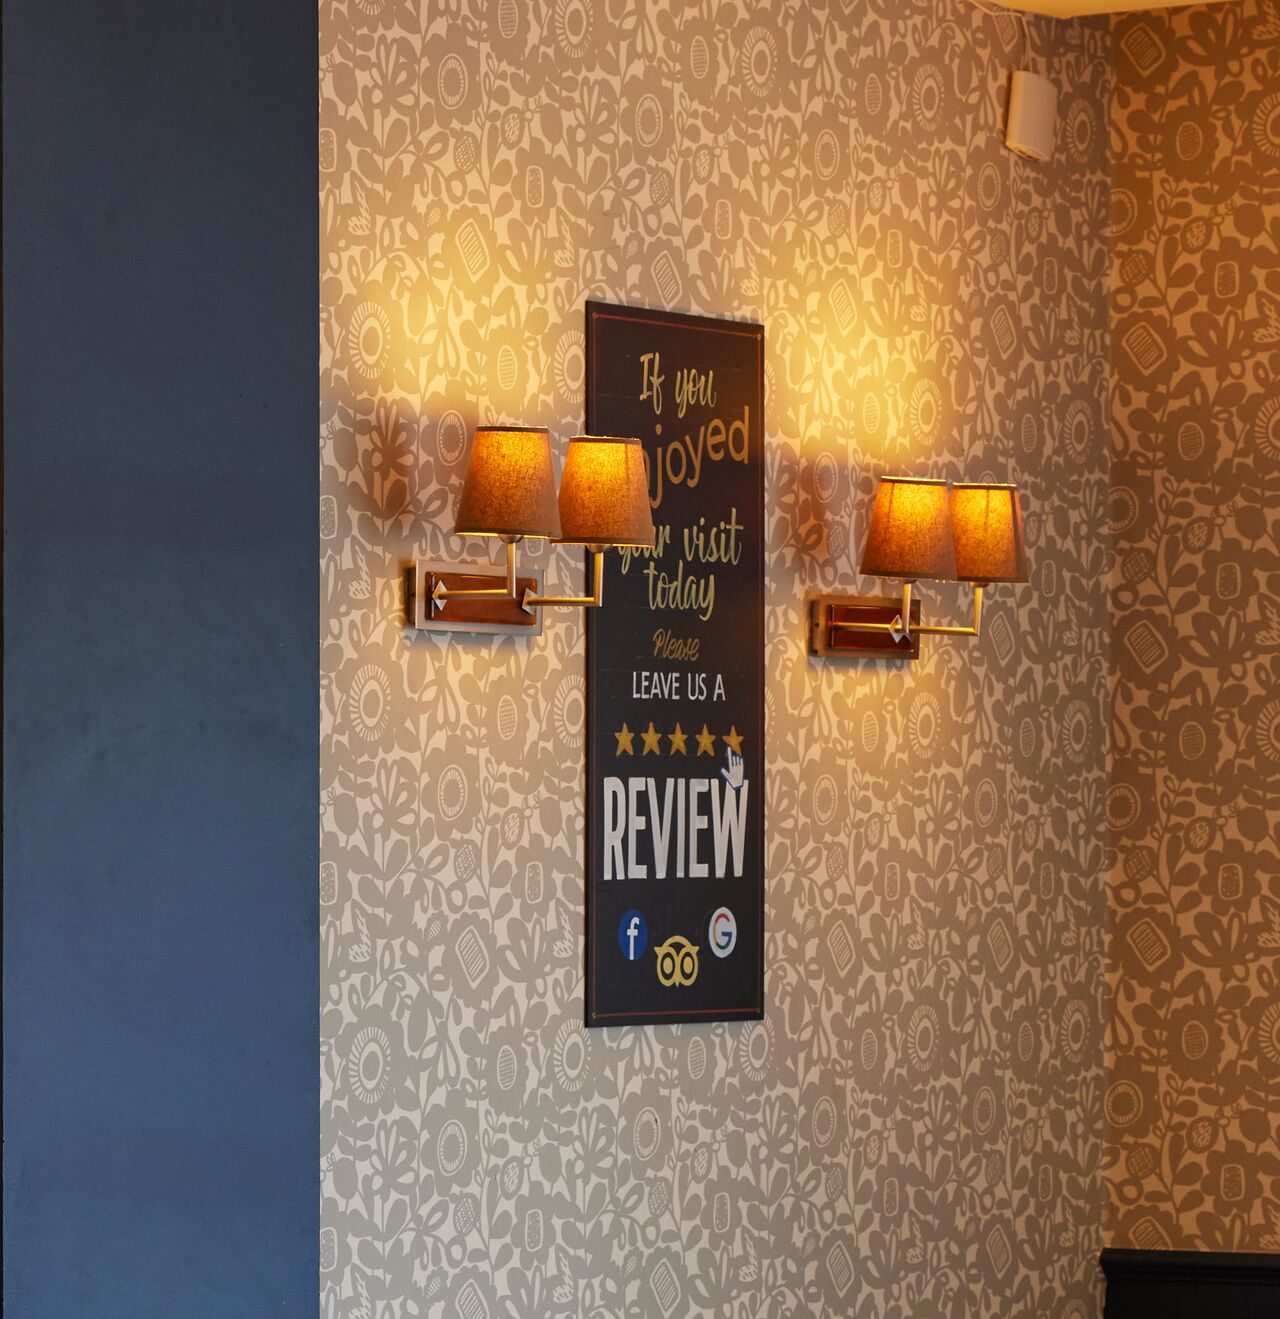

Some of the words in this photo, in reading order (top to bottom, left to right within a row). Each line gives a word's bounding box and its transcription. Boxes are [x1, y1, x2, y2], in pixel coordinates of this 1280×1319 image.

[639, 352, 665, 415] If
[675, 368, 717, 418] you
[683, 507, 745, 566] visit
[643, 559, 715, 621] today
[652, 628, 700, 661] Please
[632, 671, 680, 700] LEAVE
[687, 672, 707, 701] US
[713, 673, 726, 701] A
[603, 776, 749, 881] REVIEW
